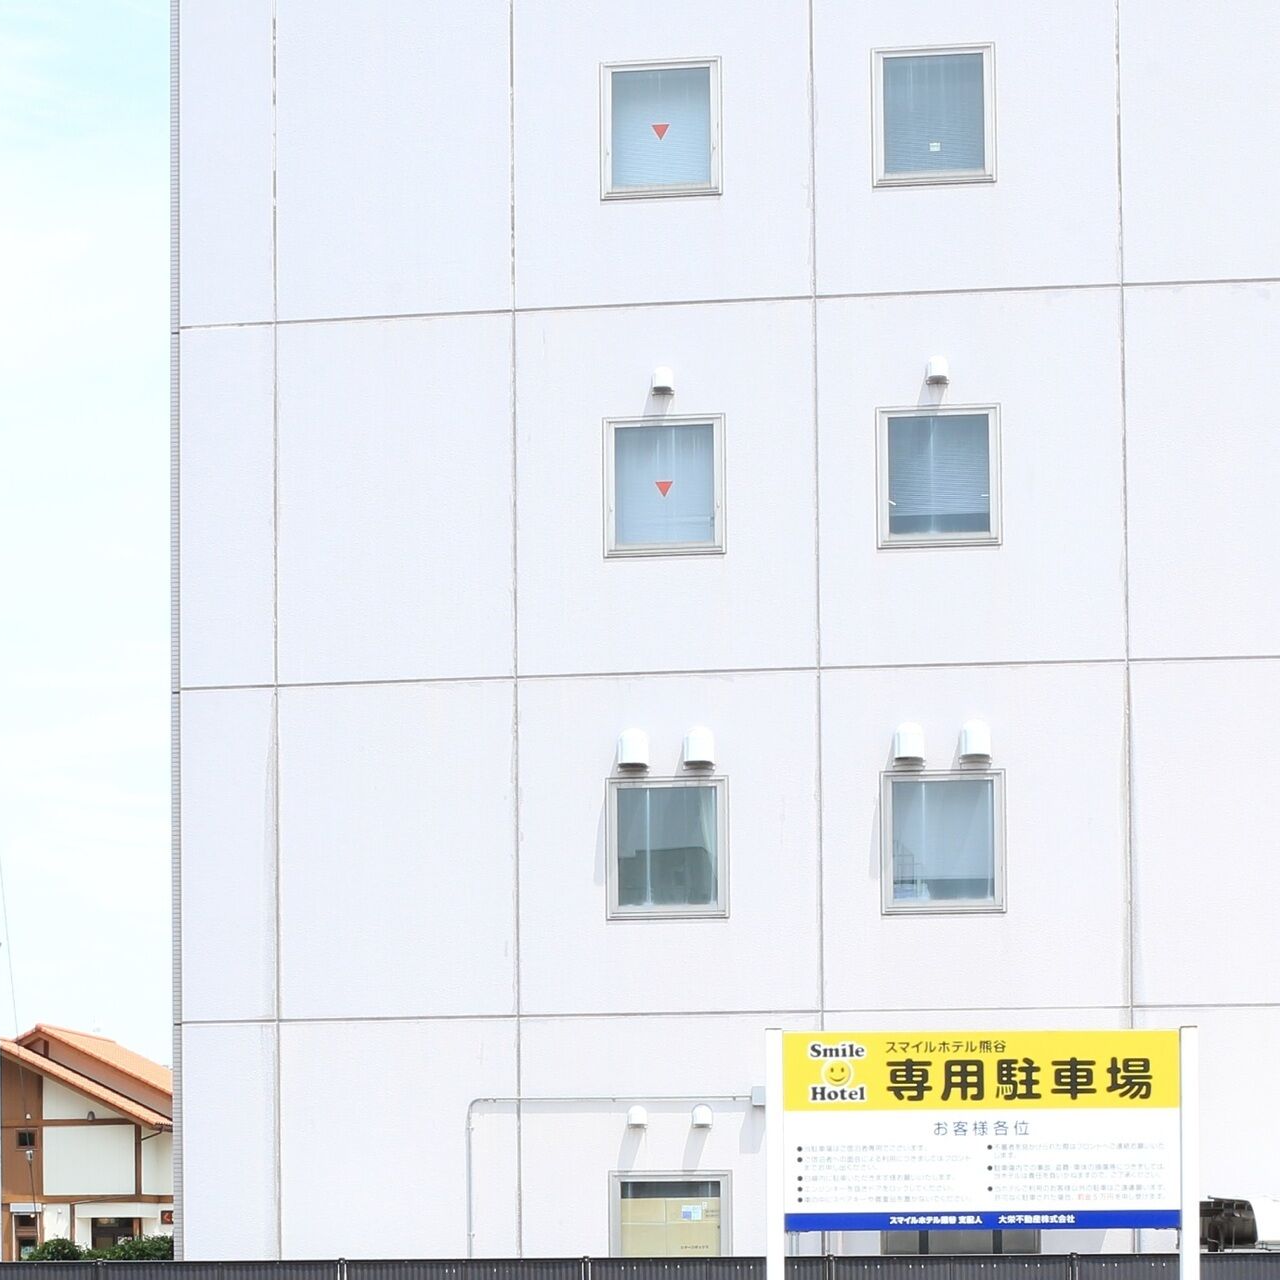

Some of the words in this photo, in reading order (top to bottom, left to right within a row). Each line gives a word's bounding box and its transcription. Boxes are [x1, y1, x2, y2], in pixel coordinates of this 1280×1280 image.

[810, 1044, 865, 1058] Smile
[885, 1040, 1007, 1054] スマイルホテル熊谷
[885, 1056, 1154, 1102] 専用駐車場
[811, 1086, 865, 1101] Hotel
[933, 1120, 1030, 1137] お客様各位
[998, 1213, 1076, 1224] 大栄不動産株式会社
